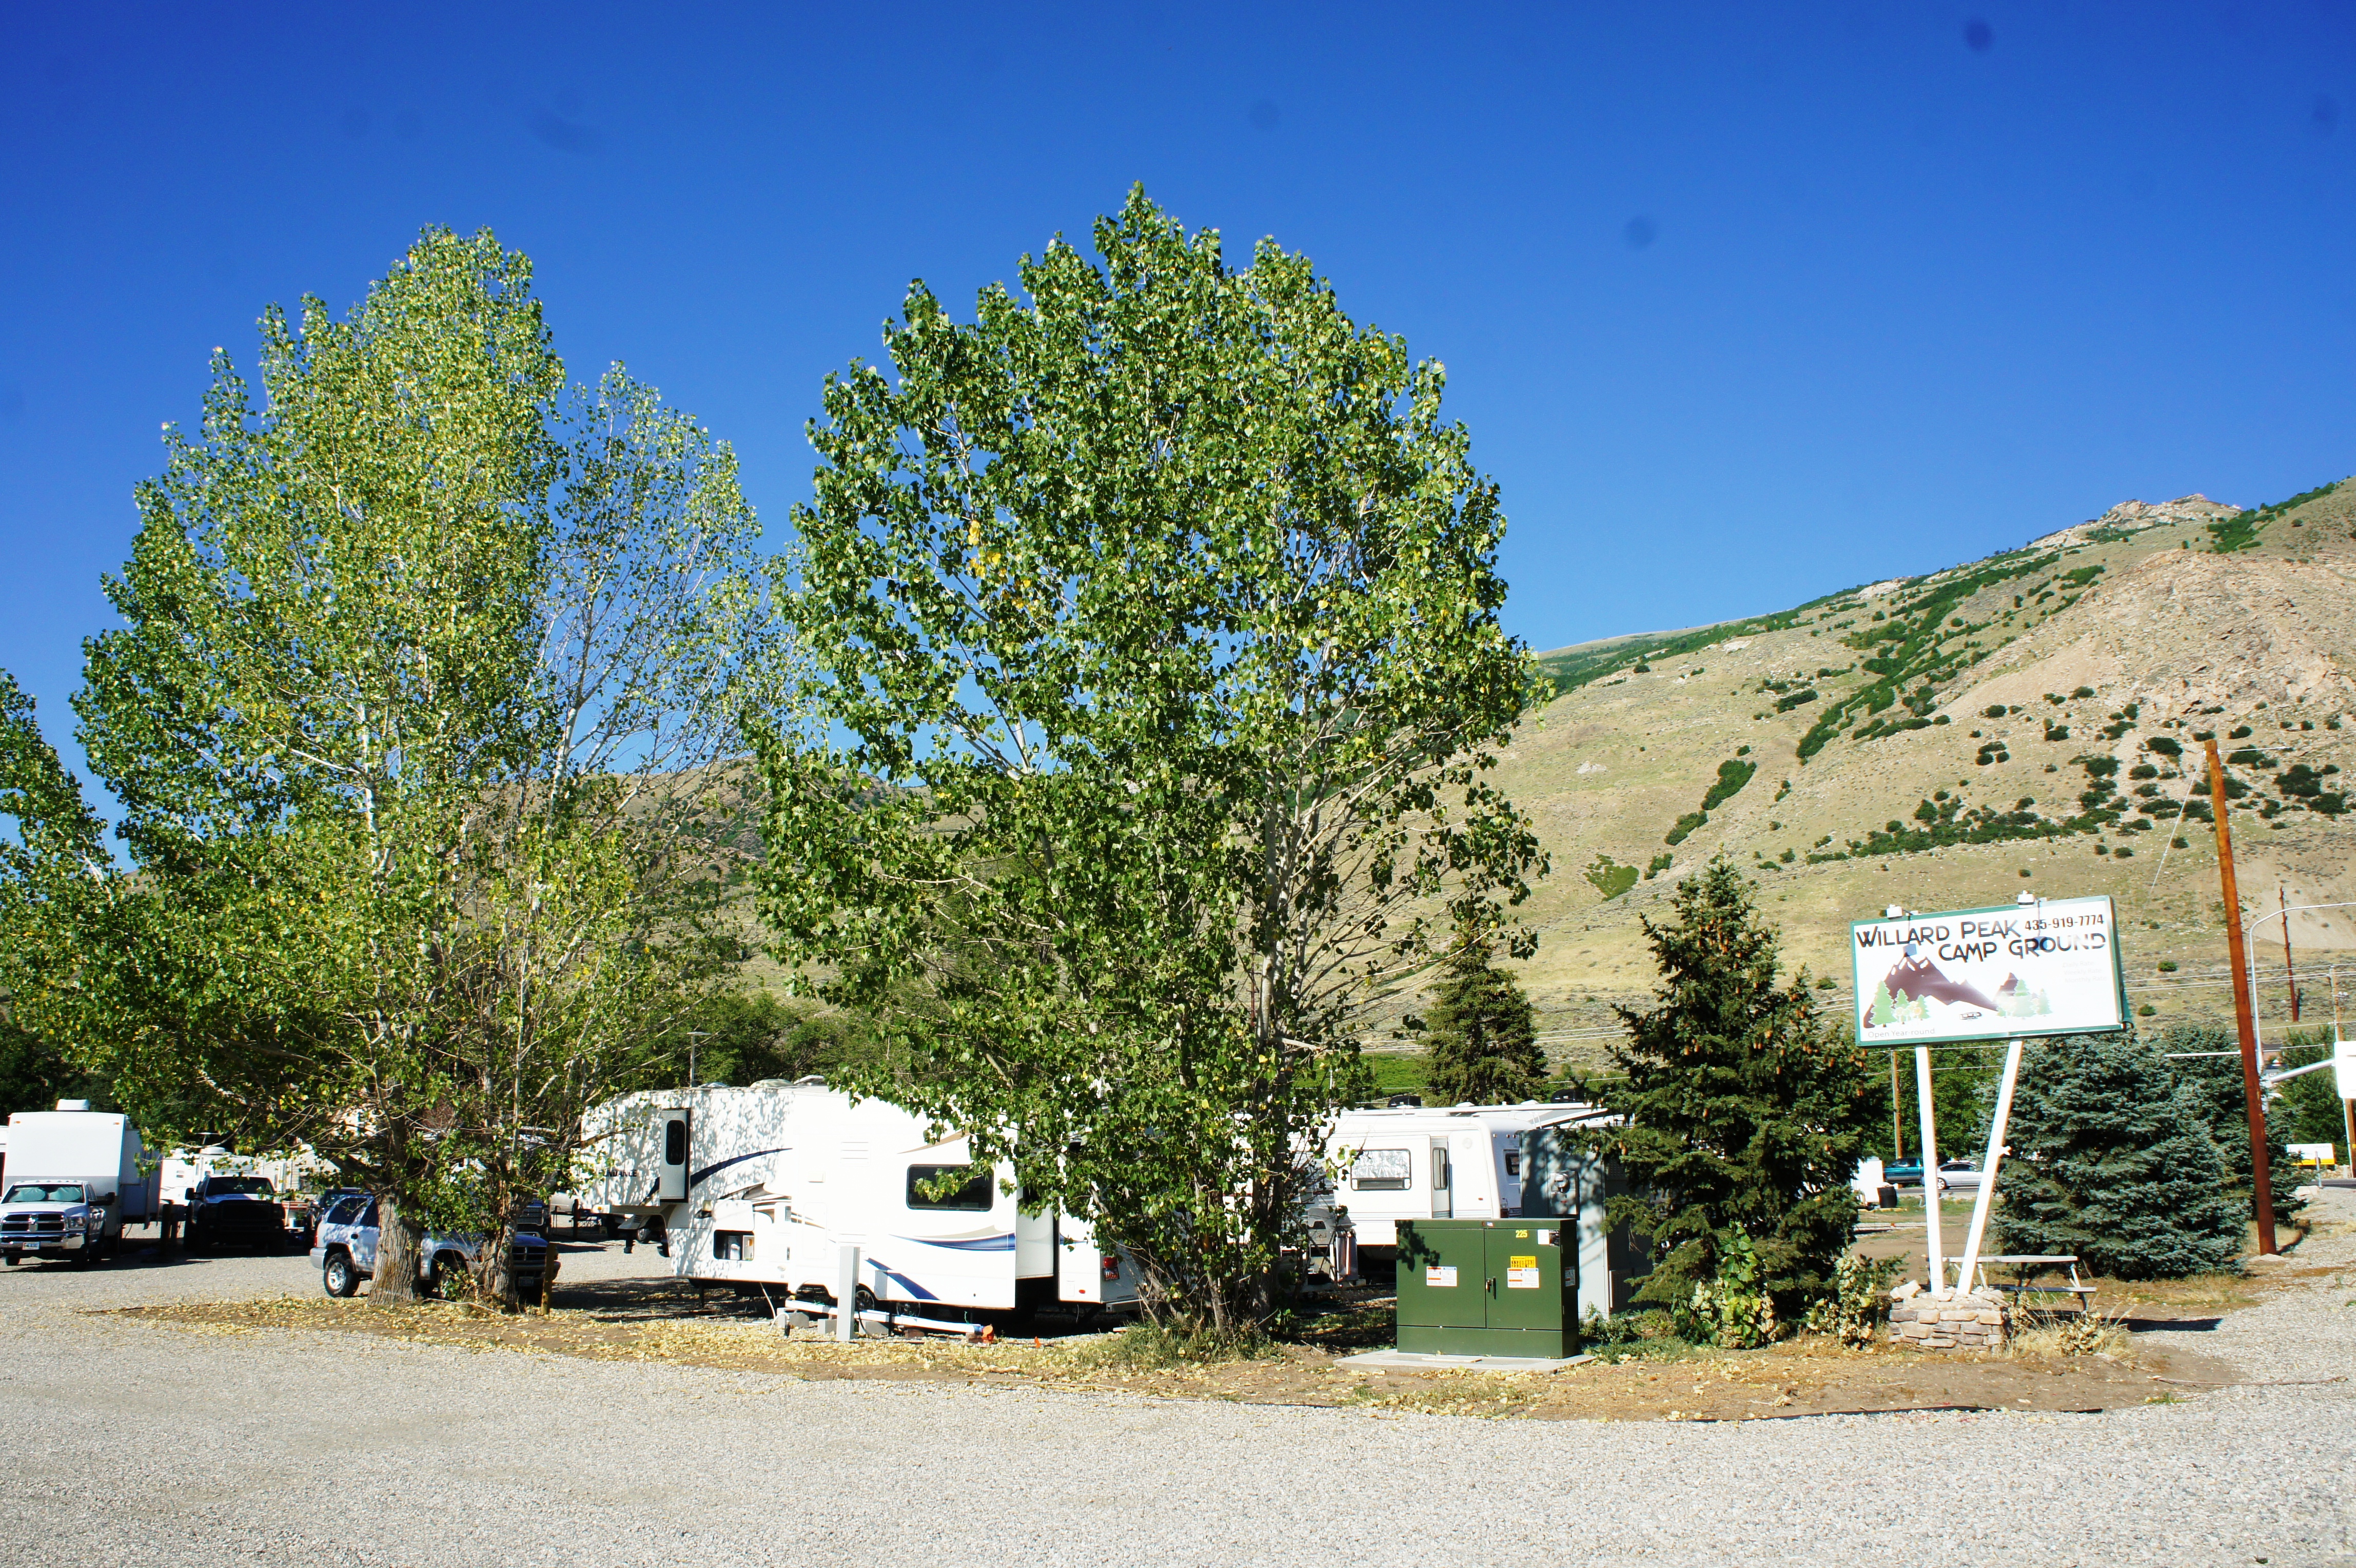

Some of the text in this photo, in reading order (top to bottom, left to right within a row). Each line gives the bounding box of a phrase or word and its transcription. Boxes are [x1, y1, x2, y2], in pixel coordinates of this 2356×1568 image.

[2025, 914, 2105, 930] 435-919-7774
[1856, 919, 2021, 948] WILLARD PEAK
[1938, 933, 2106, 963] CAMP GROUND
[1891, 1028, 1935, 1036] Year-round
[1516, 1230, 1527, 1238] 225
